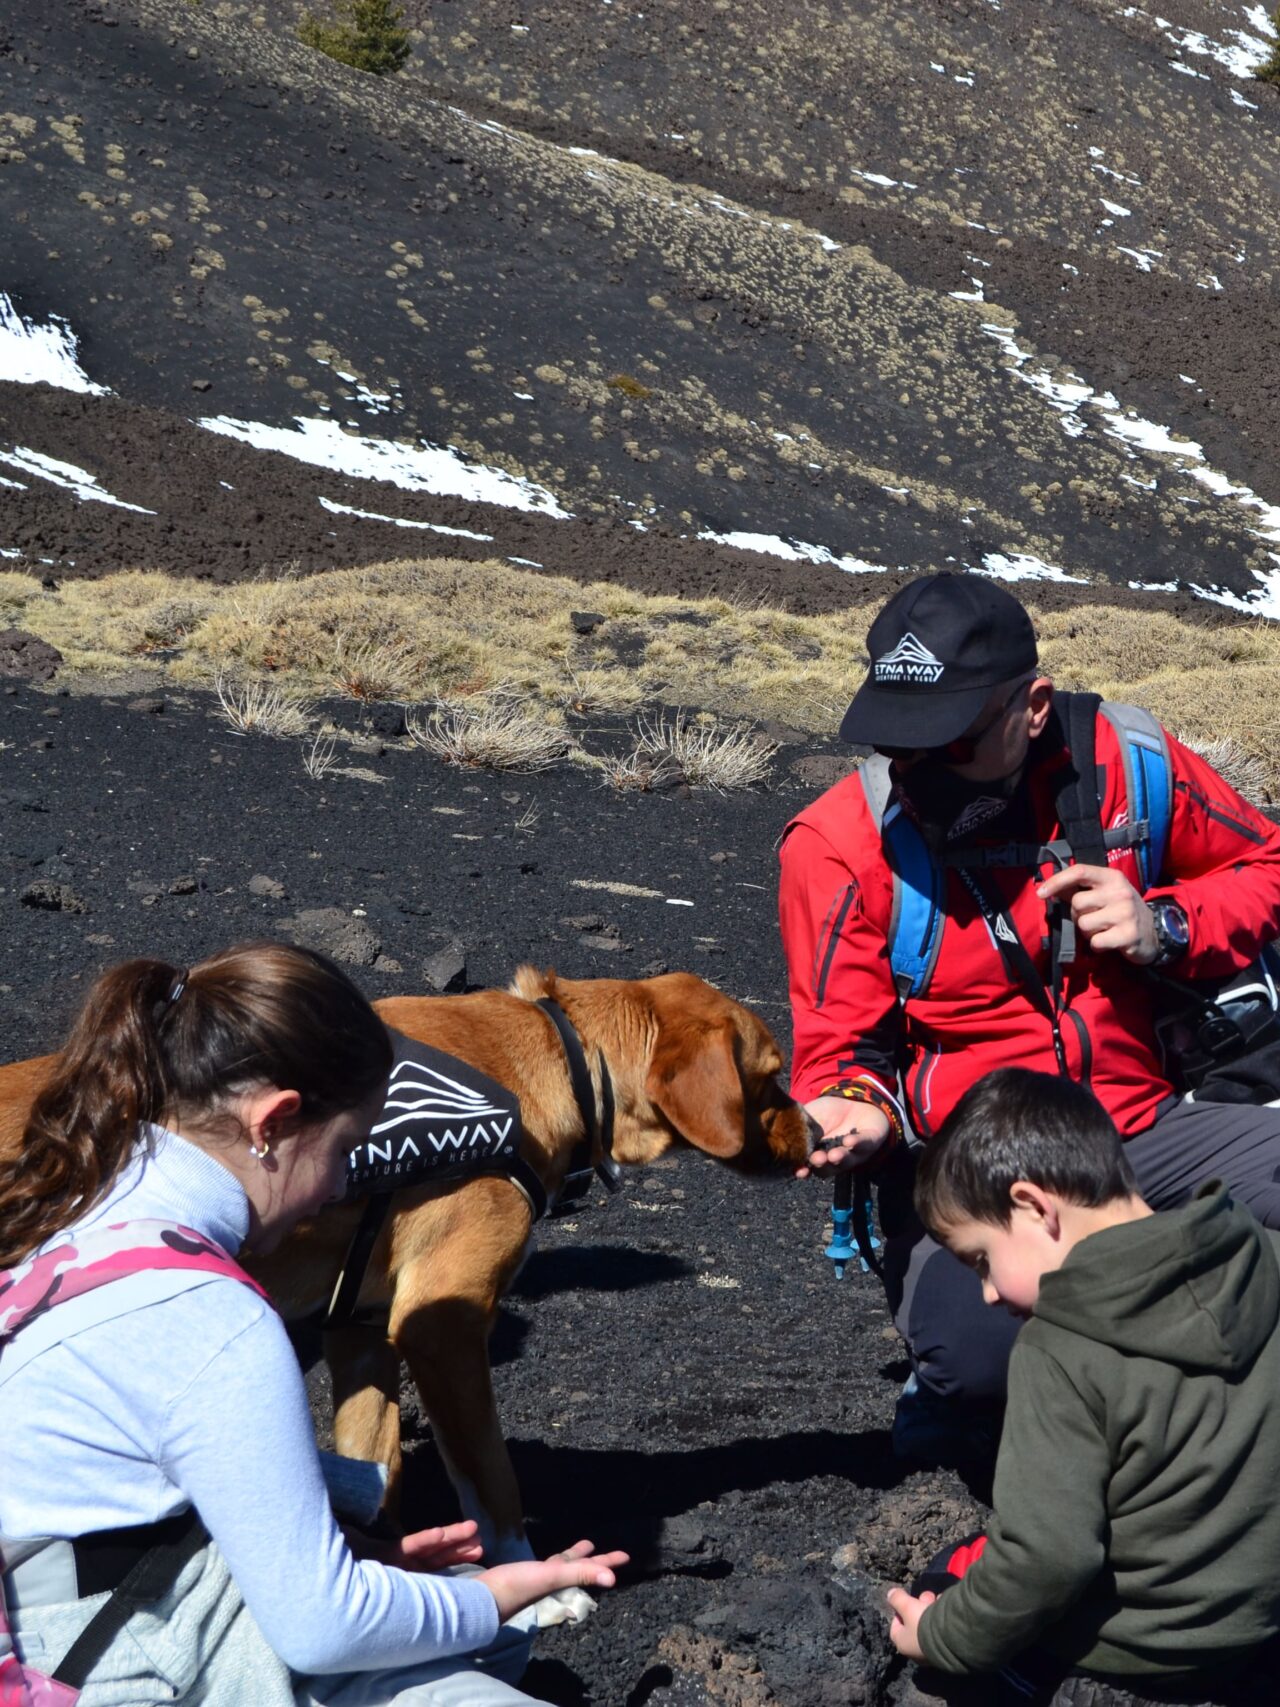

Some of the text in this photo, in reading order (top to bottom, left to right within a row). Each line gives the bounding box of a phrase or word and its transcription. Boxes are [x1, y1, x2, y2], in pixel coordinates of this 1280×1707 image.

[875, 664, 945, 682] ETNA WAY
[349, 1117, 513, 1169] TNA WAY
[423, 1155, 439, 1168] IS
[449, 1146, 489, 1163] HERE
